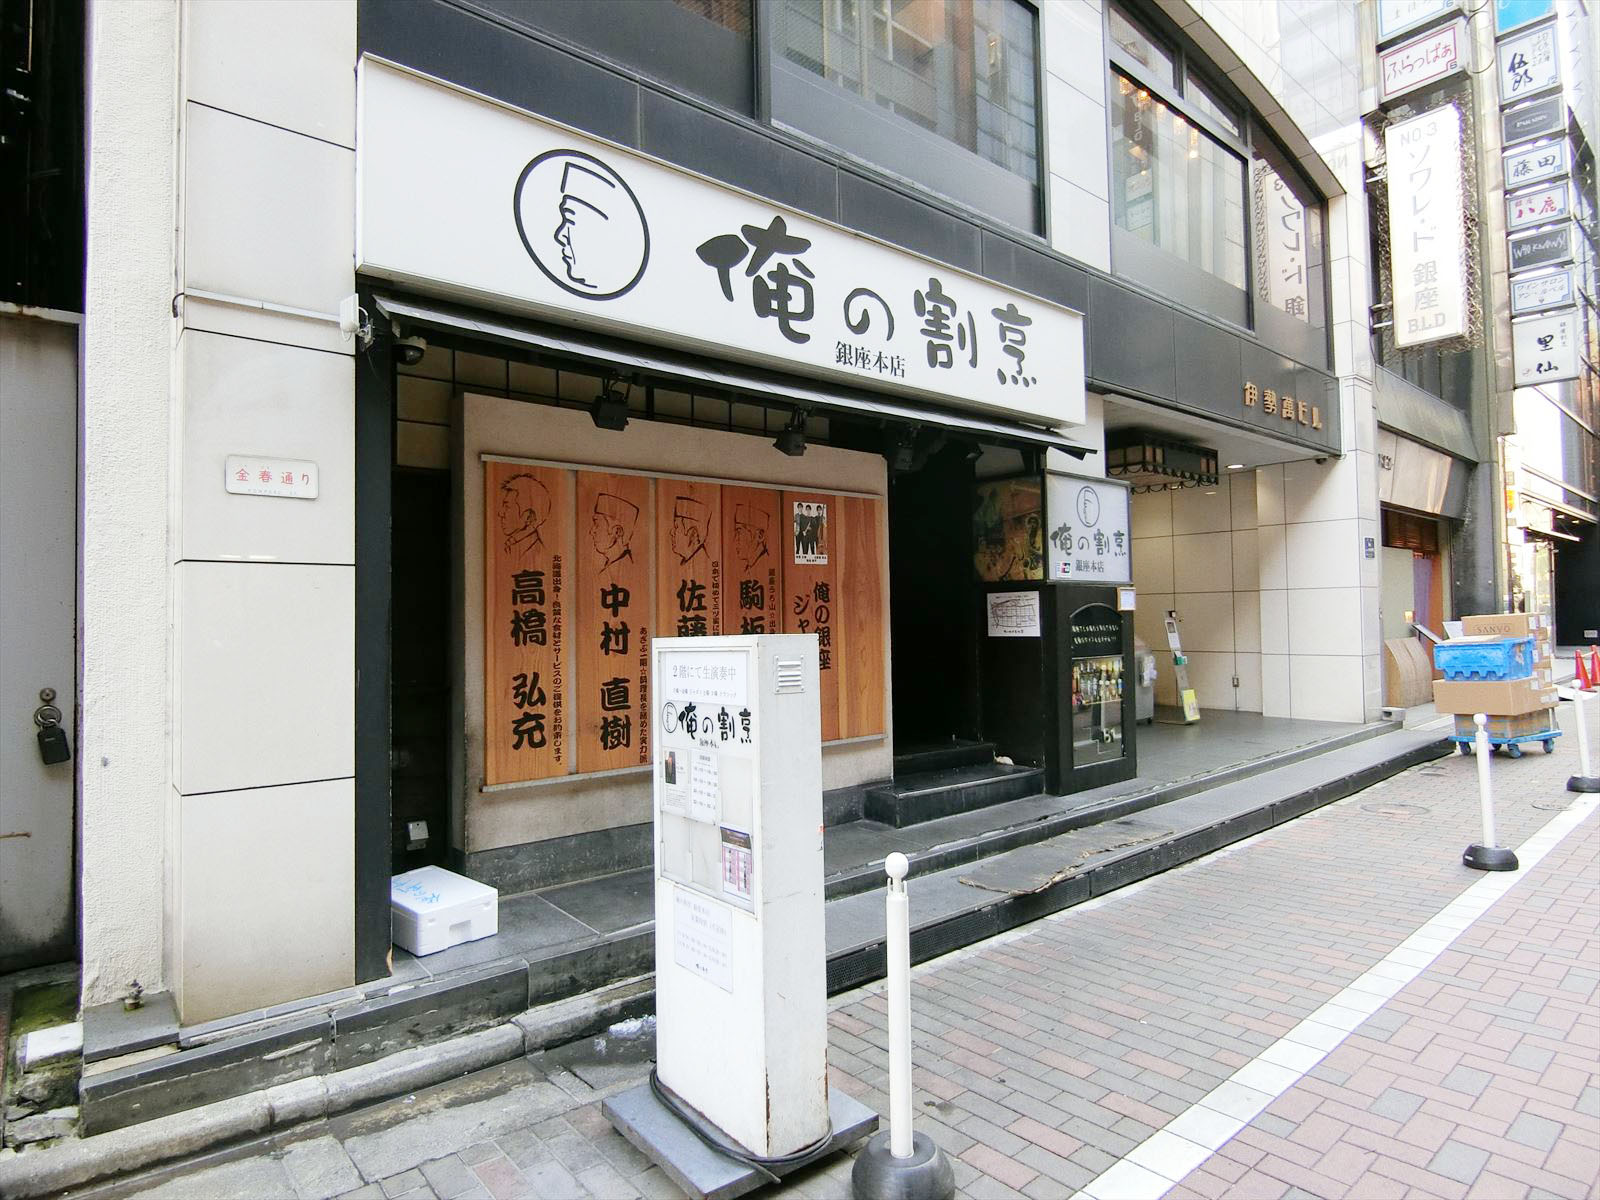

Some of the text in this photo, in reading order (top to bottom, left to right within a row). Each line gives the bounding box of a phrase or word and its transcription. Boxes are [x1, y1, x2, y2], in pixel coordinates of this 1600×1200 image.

[696, 215, 1038, 388] 俺の割烹
[835, 341, 906, 378] 銀座本店
[236, 468, 310, 485] 金春通り
[1050, 522, 1127, 557] 俺の割烹
[1075, 560, 1104, 573] 銀座本店
[511, 569, 547, 750] 高橋 弘充
[600, 583, 631, 751] 中村 直樹
[678, 701, 752, 744] 俺の割烹
